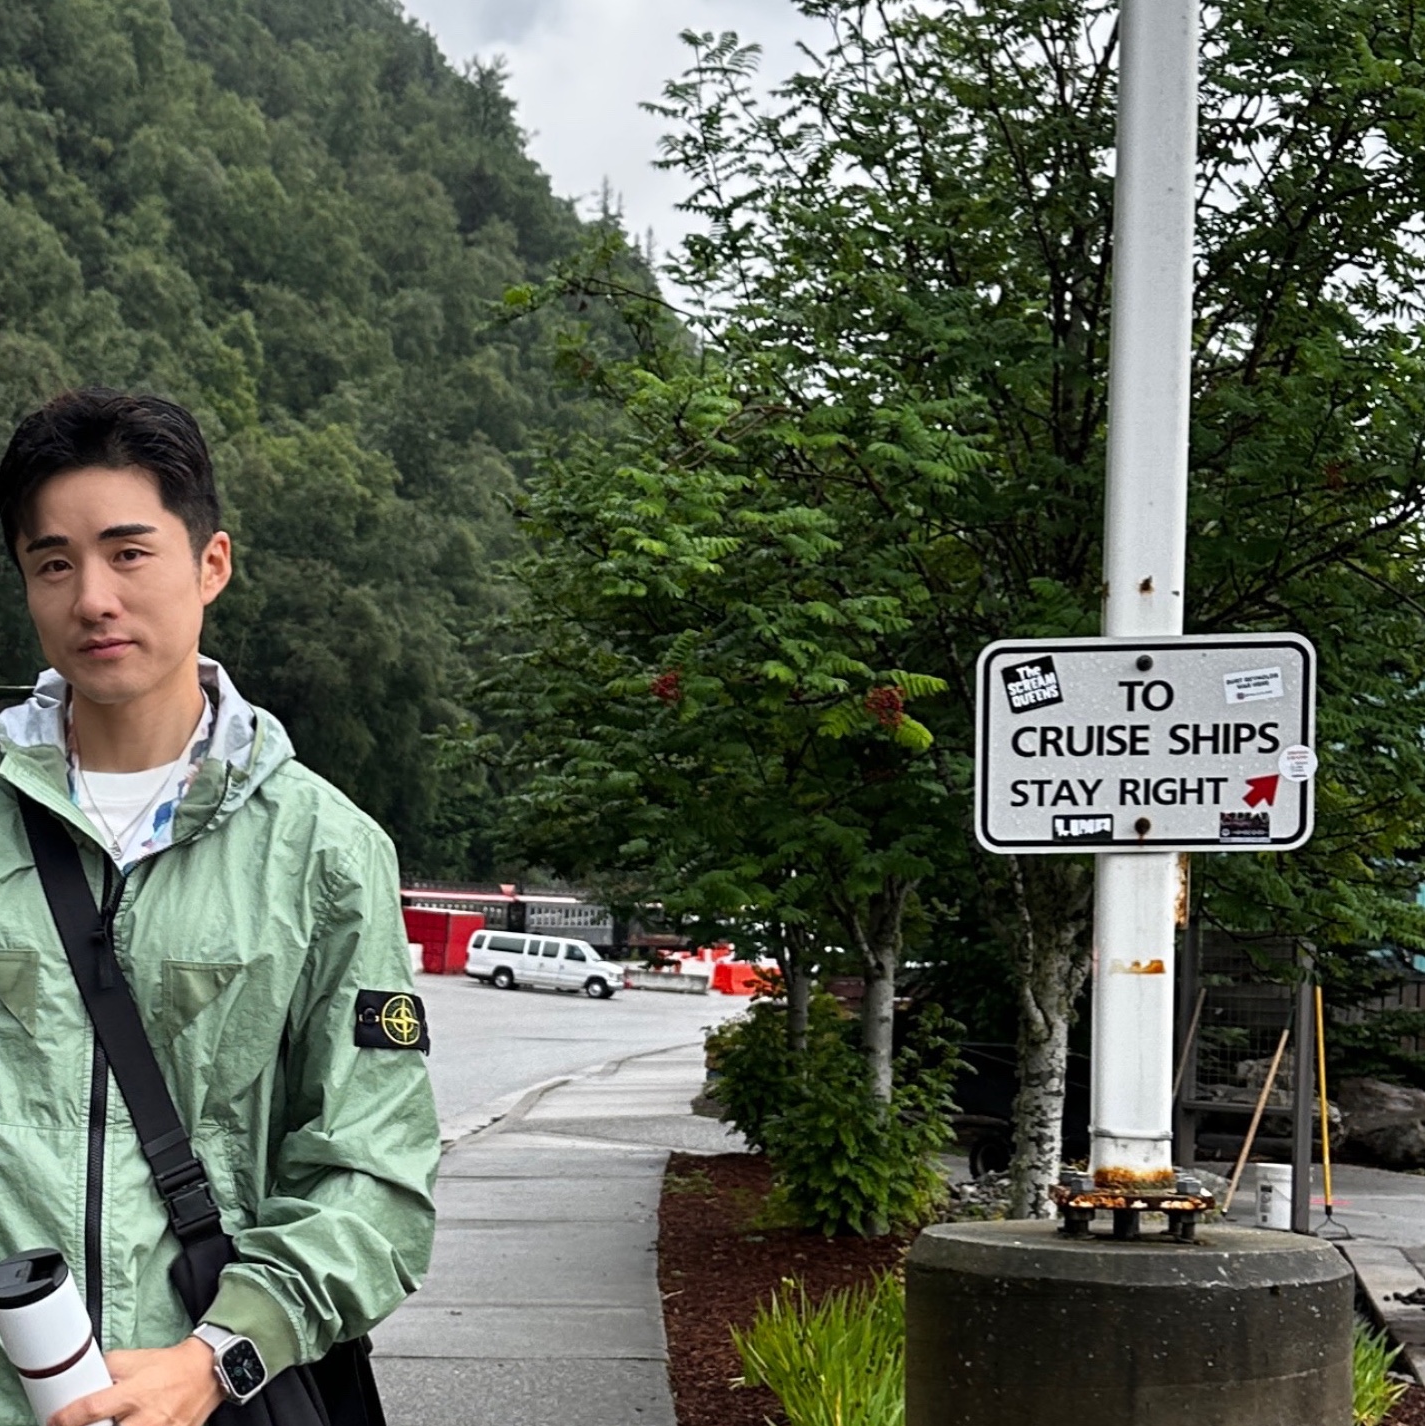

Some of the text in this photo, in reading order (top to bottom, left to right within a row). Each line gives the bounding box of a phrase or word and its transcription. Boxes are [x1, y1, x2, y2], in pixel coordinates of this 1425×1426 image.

[1007, 672, 1057, 696] SCREAM
[1016, 665, 1042, 680] The
[1011, 685, 1060, 707] QUEENS
[1118, 679, 1174, 712] TO
[1011, 722, 1280, 757] CRUISE SHIPS
[1010, 777, 1229, 807] STAY RIGHT
